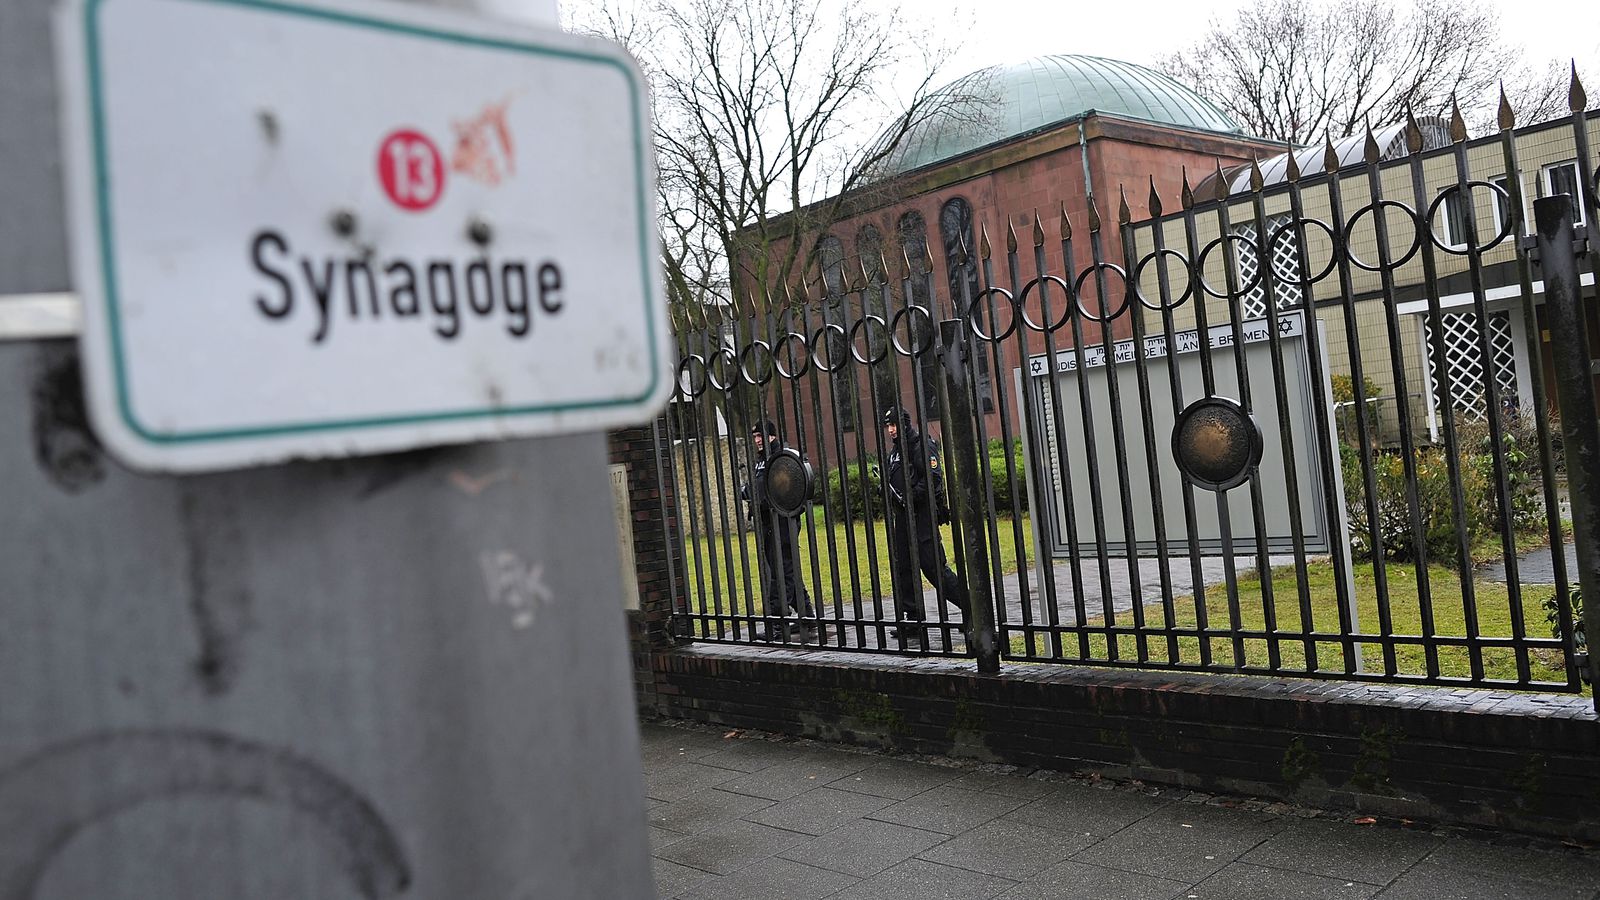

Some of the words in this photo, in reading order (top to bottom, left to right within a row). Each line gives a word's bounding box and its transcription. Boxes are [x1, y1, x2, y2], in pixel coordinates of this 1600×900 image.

[389, 138, 435, 203] 13
[249, 229, 565, 344] Synagoge
[1055, 356, 1098, 371] DISHE
[1218, 329, 1271, 345] BRMEN
[1179, 332, 1198, 341] הילה
